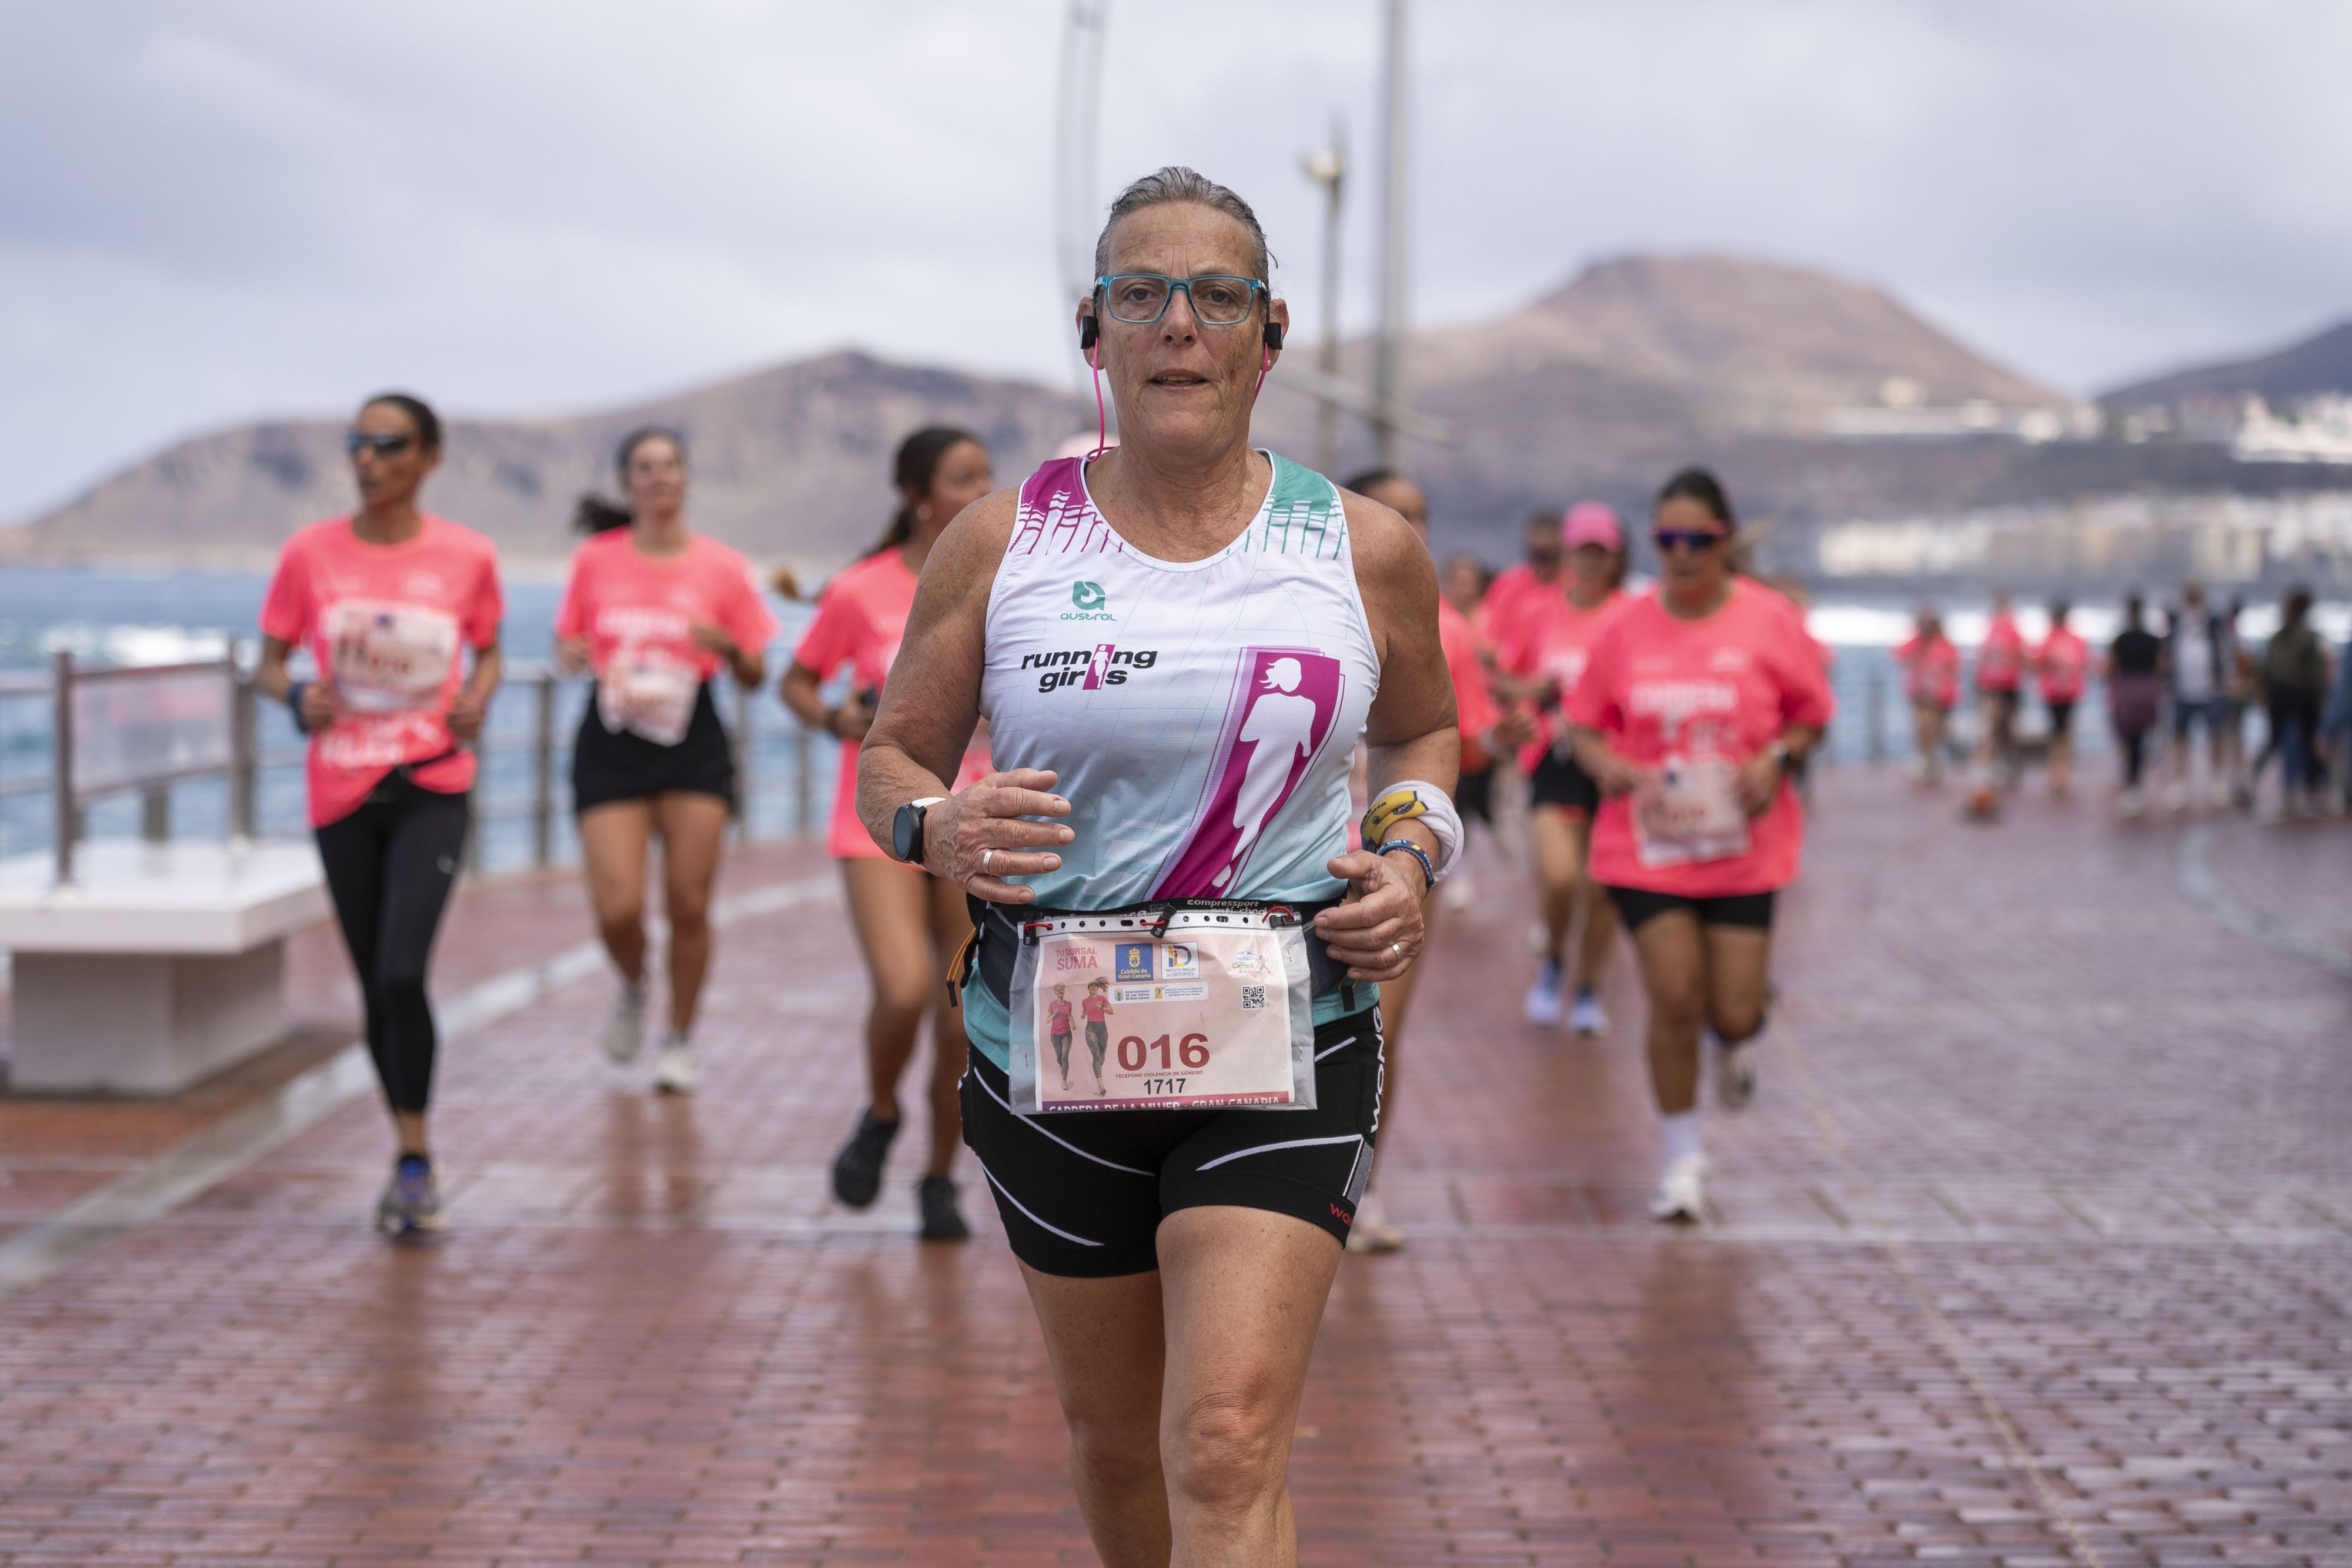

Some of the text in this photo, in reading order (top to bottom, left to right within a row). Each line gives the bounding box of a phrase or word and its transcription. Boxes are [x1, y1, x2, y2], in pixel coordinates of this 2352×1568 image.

[1060, 613, 1118, 621] austral
[1187, 899, 1259, 909] compressport
[1065, 947, 1098, 956] DORSAL
[1057, 955, 1098, 971] SUMA
[1117, 1033, 1210, 1071] 016
[1144, 1078, 1187, 1095] 1717
